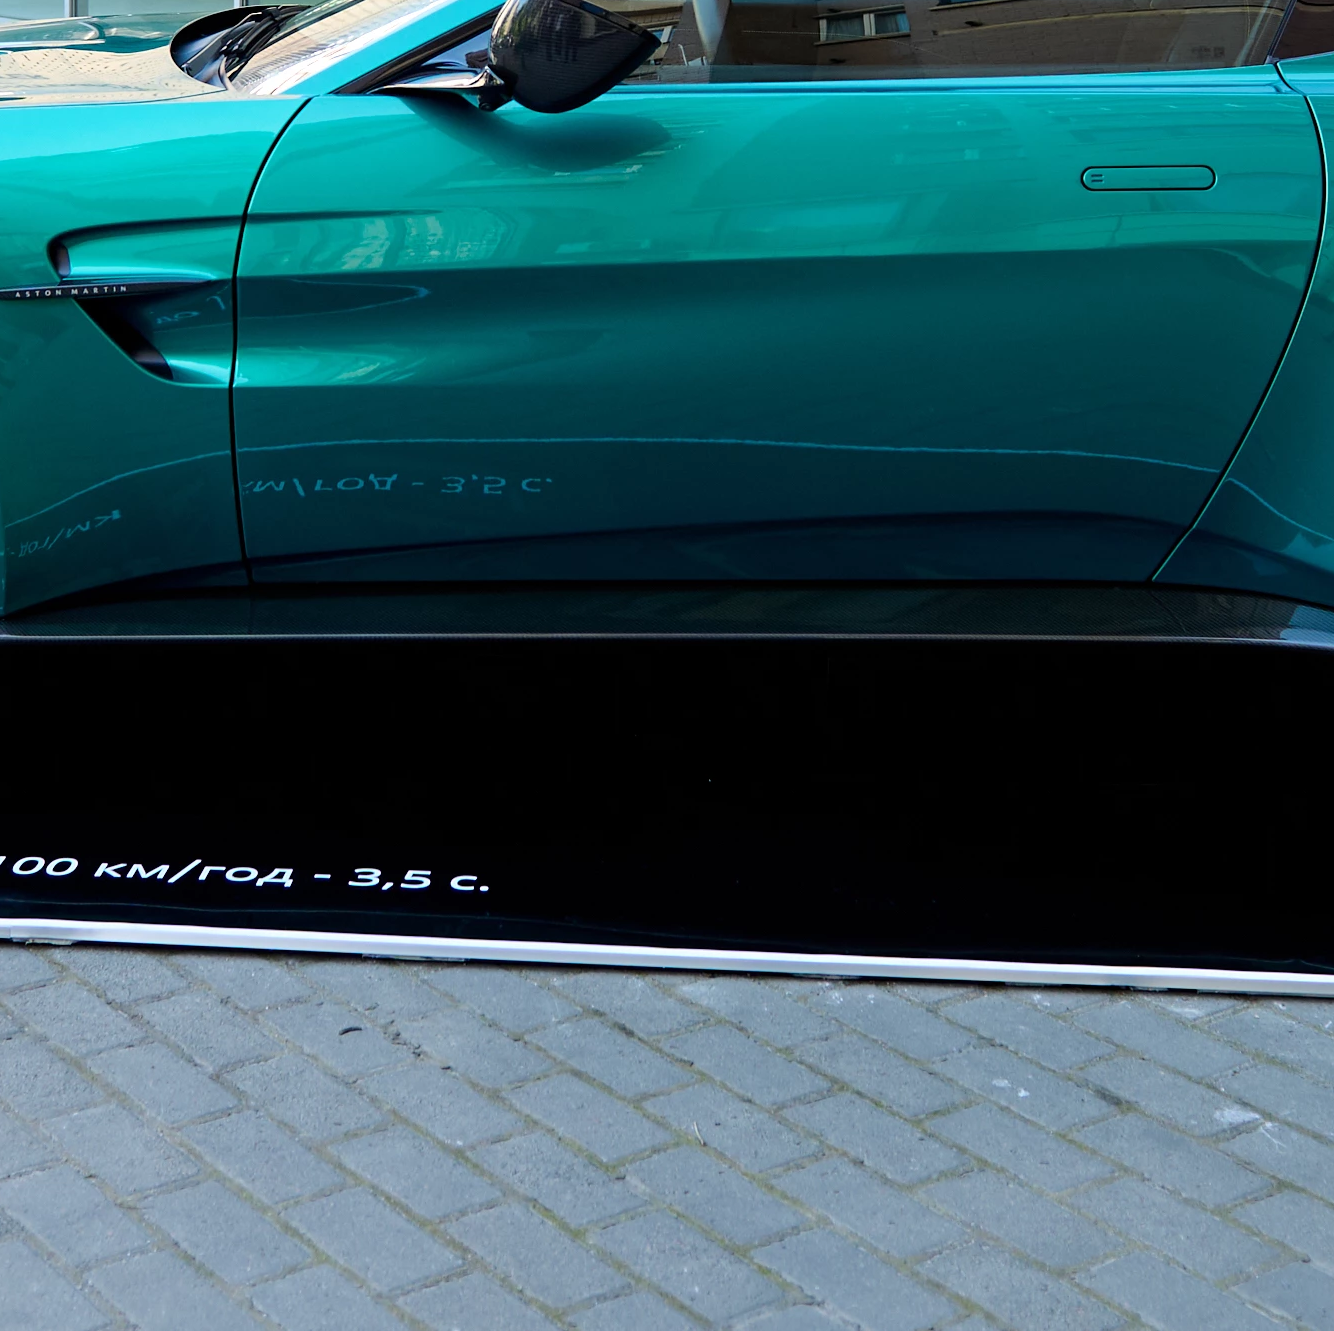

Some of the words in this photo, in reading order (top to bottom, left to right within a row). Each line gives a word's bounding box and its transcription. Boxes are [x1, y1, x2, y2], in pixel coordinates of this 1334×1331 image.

[15, 289, 62, 298] ASTON
[71, 286, 127, 295] MARTIN
[94, 859, 294, 888] км/год
[348, 868, 432, 891] 3,5
[450, 875, 490, 892] с.
